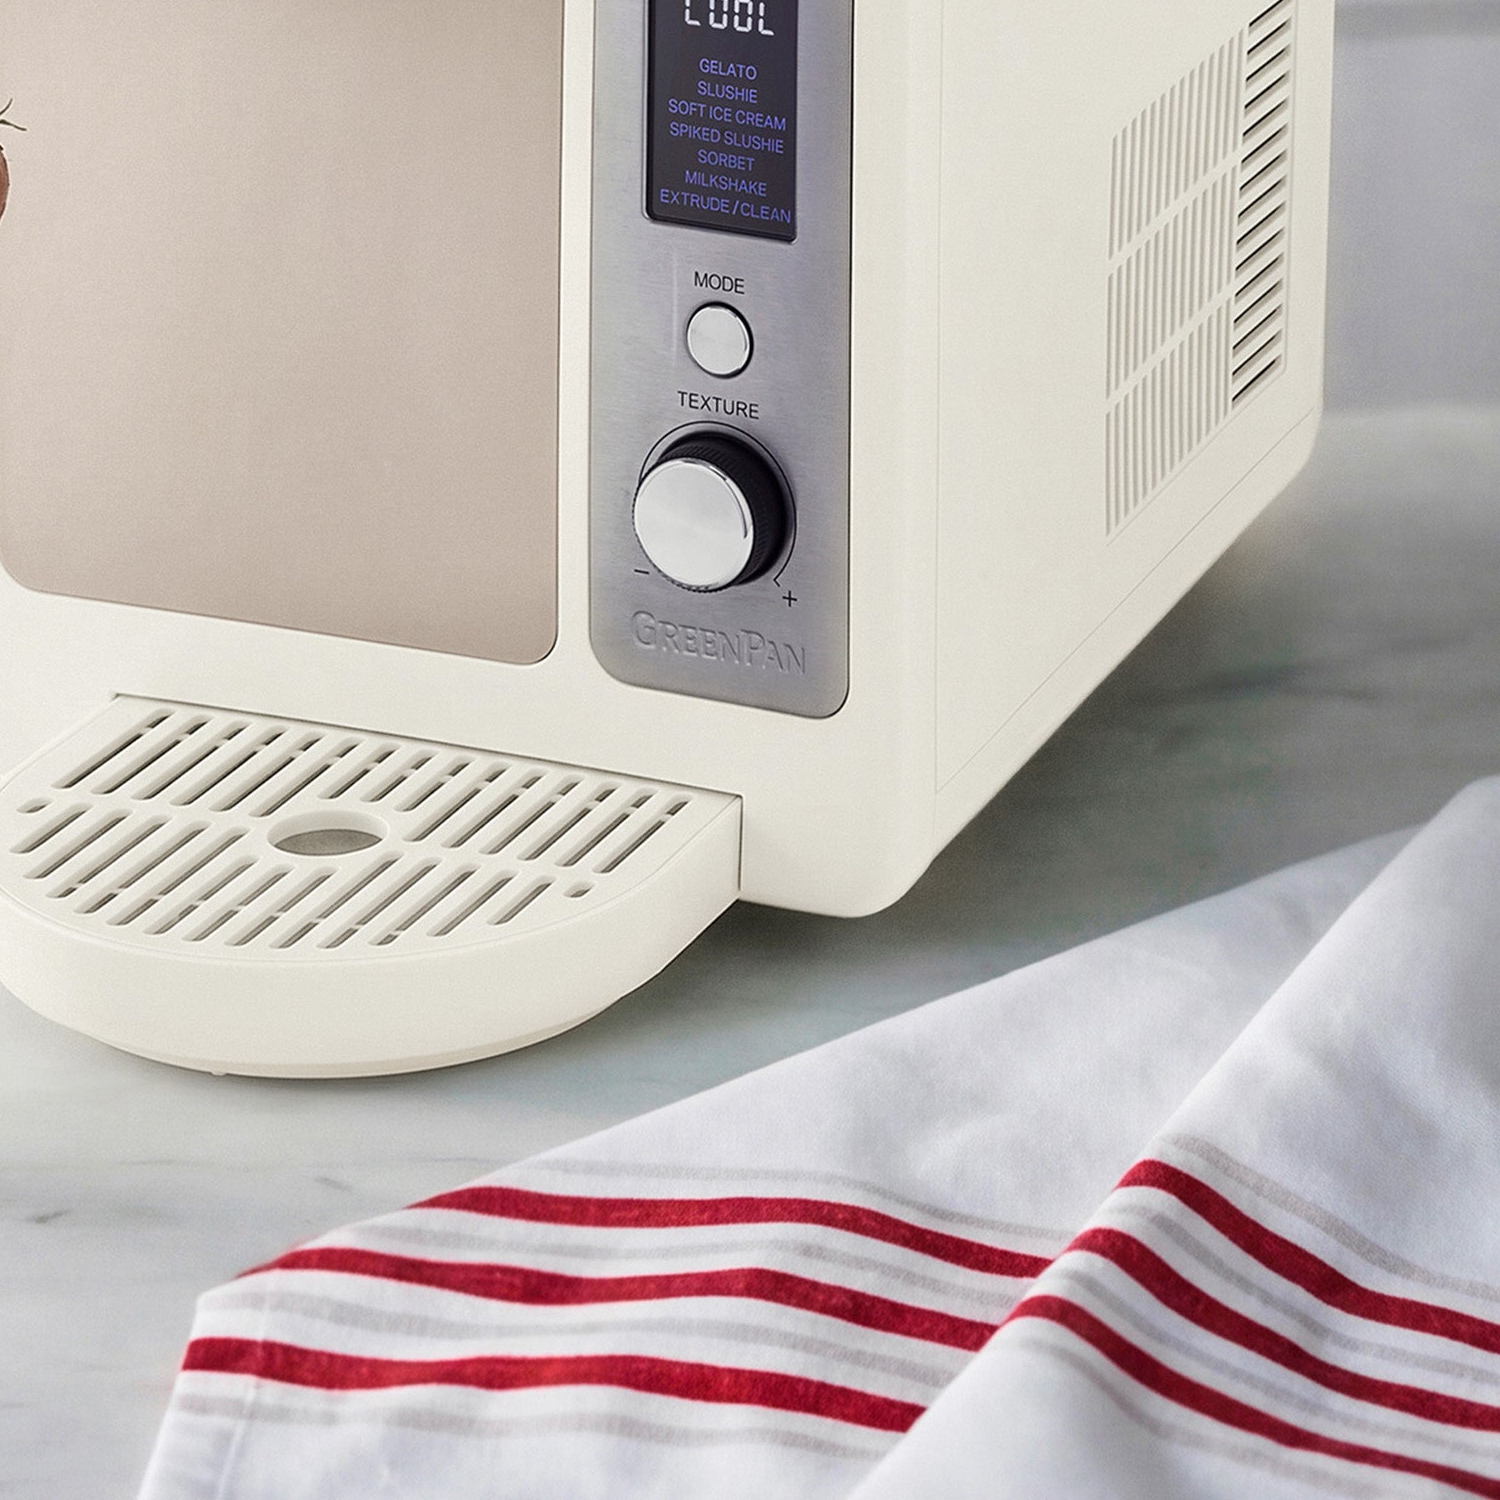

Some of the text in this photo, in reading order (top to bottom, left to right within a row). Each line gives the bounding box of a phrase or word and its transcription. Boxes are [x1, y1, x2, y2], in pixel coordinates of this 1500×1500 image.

[699, 58, 757, 80] GELATO
[697, 80, 758, 103] SLUSHIE
[668, 98, 787, 131] SOFT ICE CREAM
[669, 121, 784, 154] SPIKED SLUSHIE
[697, 149, 755, 171] SORBET
[685, 170, 767, 197] MILKSHAKE
[693, 271, 745, 295] MODE
[677, 390, 760, 420] TEXTURE
